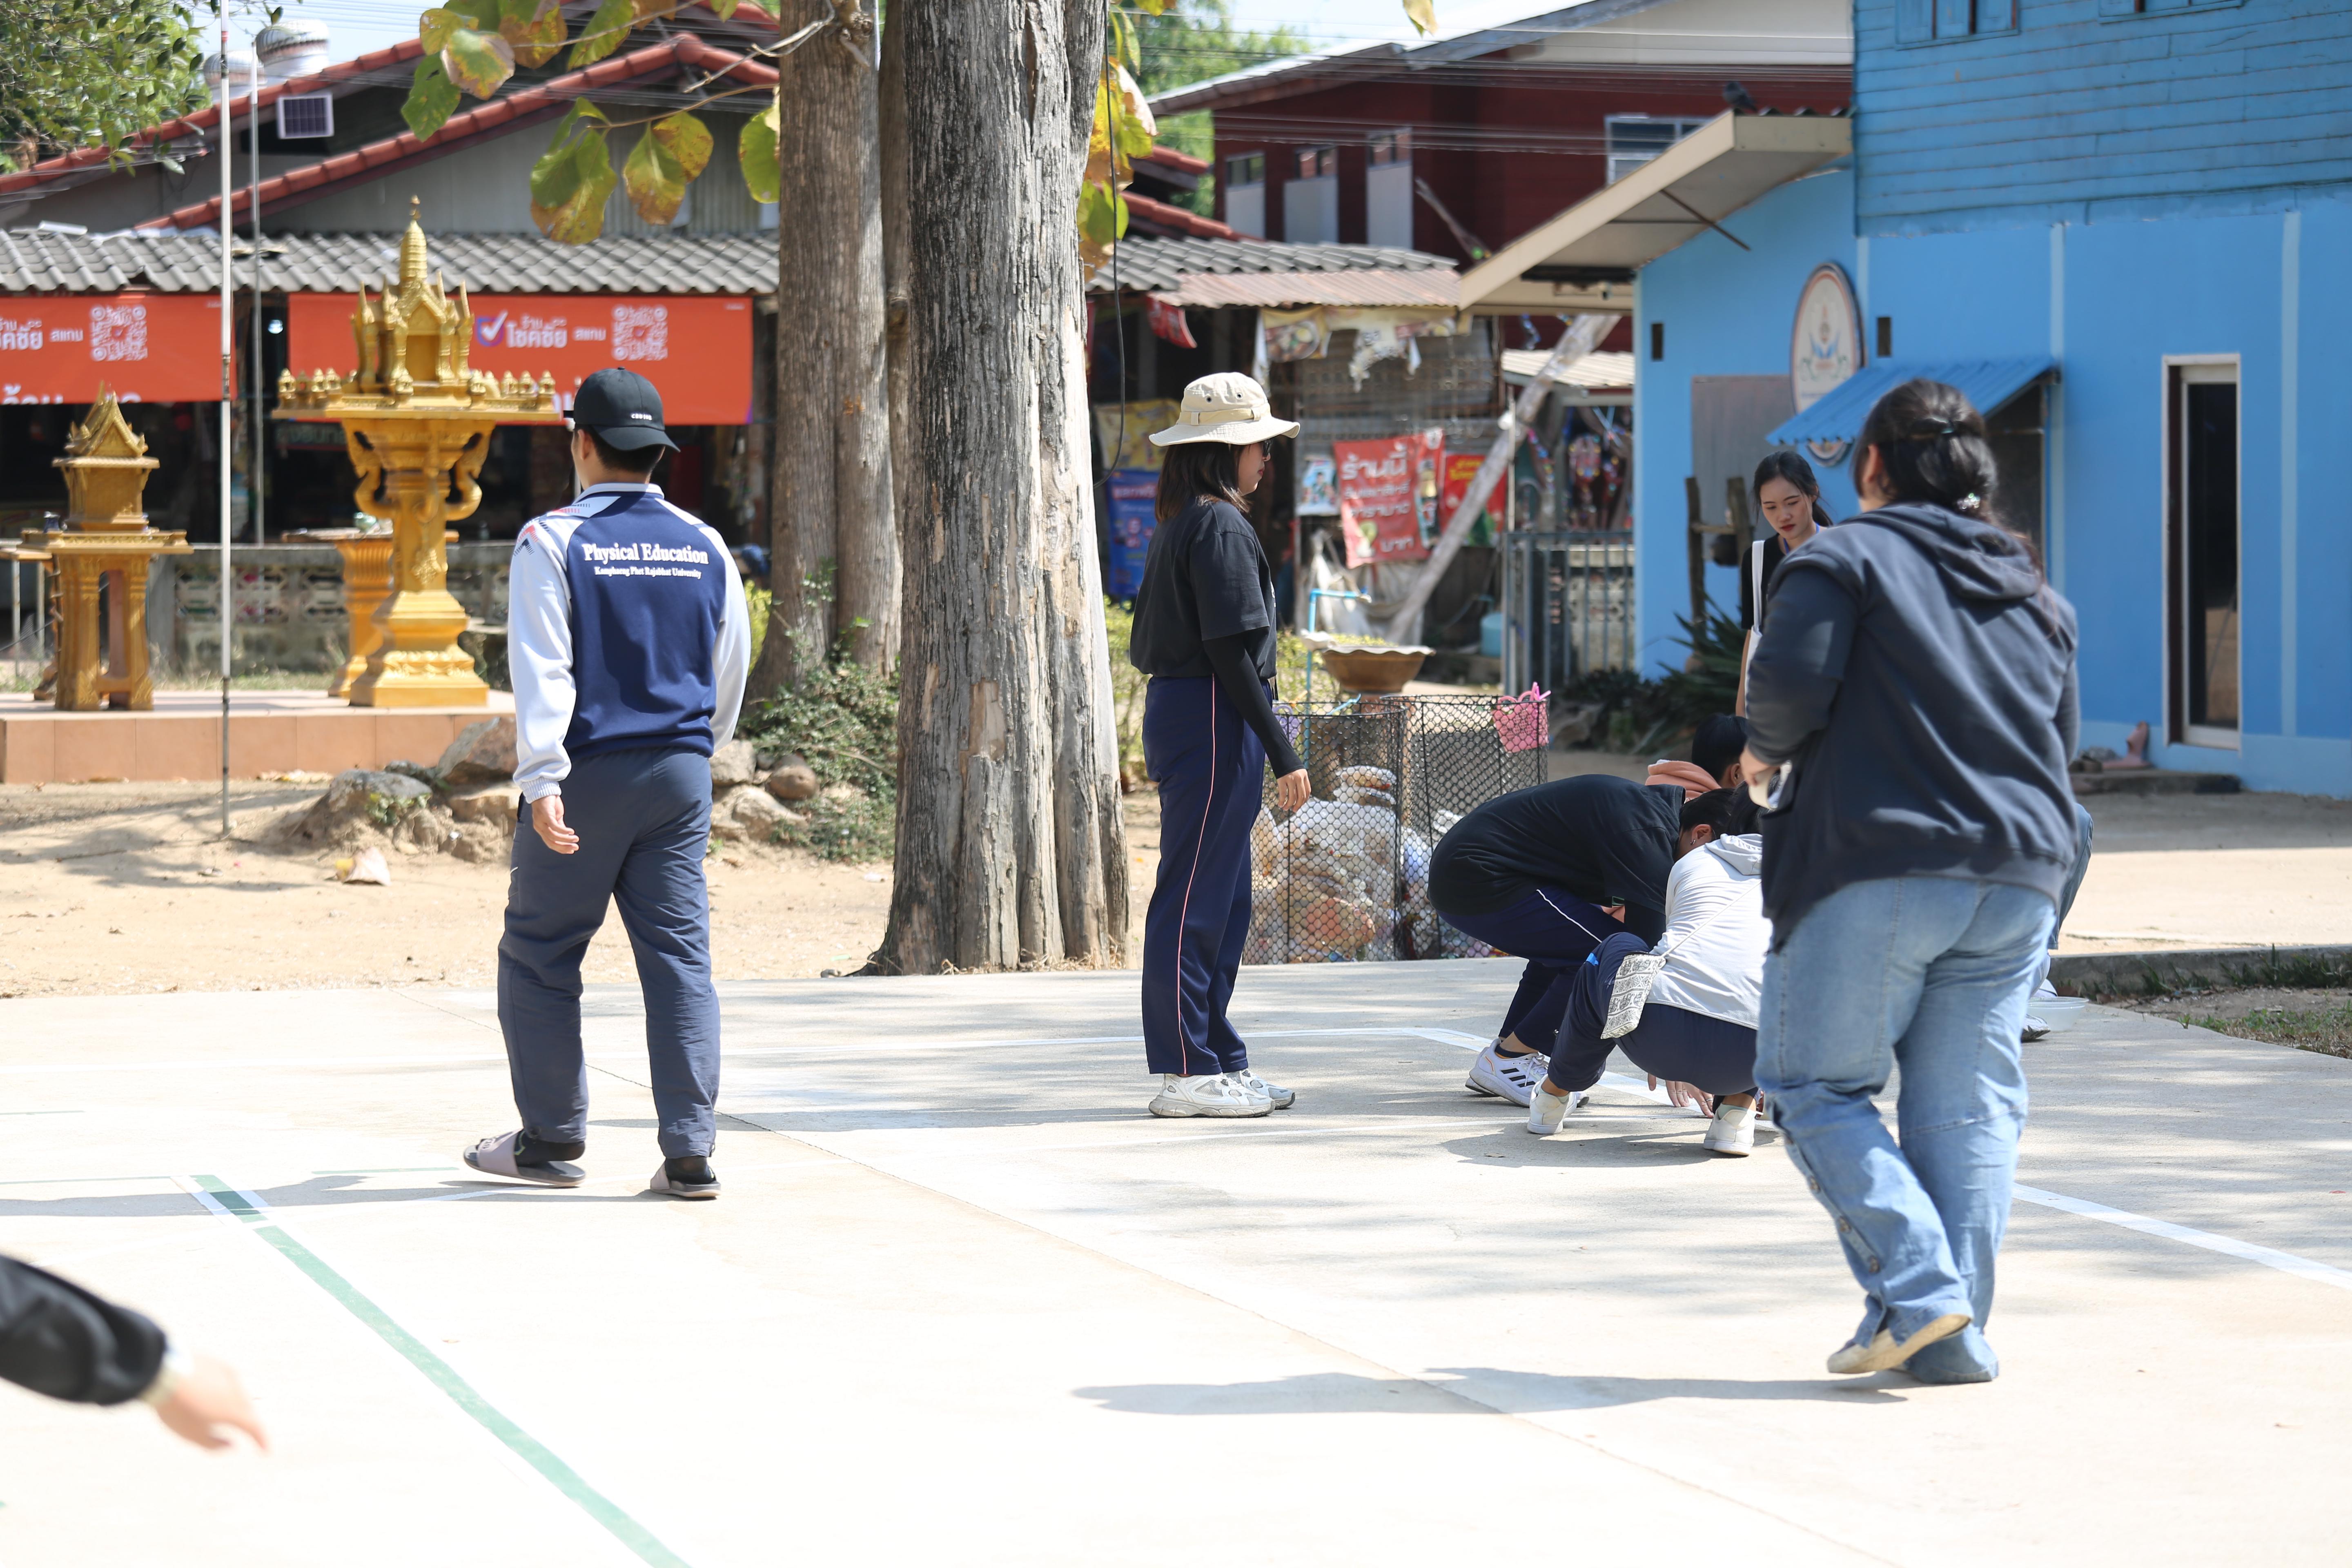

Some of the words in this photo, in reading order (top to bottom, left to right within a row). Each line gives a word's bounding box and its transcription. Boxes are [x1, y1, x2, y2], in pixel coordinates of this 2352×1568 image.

[521, 313, 543, 330] ร้าน
[0, 325, 43, 350] คชัย
[51, 329, 83, 341] สแกน
[574, 328, 606, 341] สแกน
[582, 543, 640, 564] Physical
[641, 543, 708, 564] Education
[595, 567, 630, 576] Kamphaeng
[630, 567, 644, 575] Phet
[644, 567, 671, 577] Rajabhat
[672, 568, 702, 579] University
